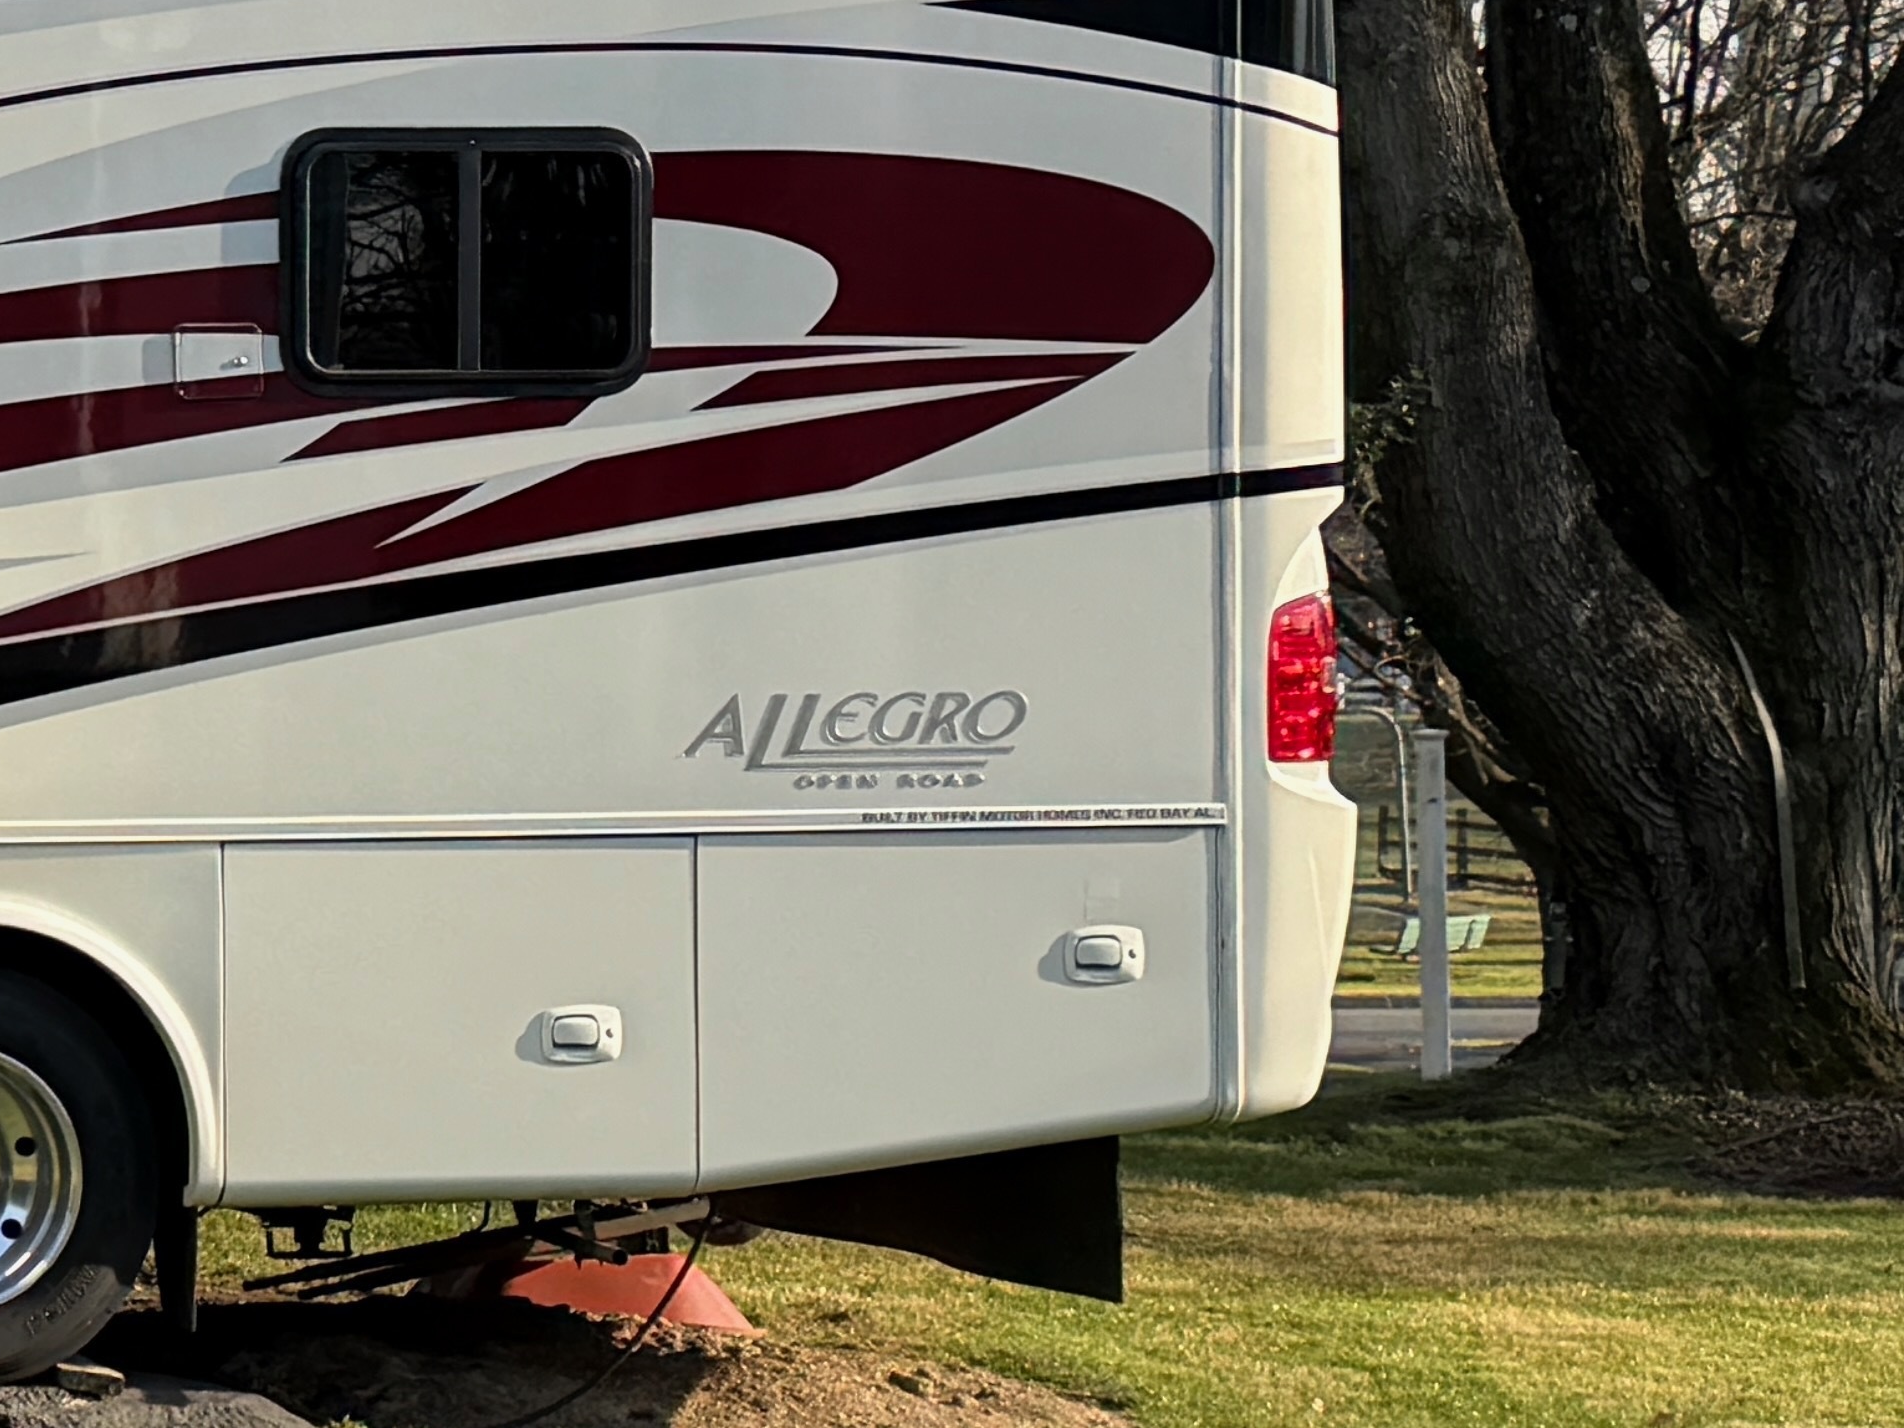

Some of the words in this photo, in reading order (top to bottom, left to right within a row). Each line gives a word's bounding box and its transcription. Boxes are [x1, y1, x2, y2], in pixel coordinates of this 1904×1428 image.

[681, 689, 1028, 771] ALLEGRO
[792, 774, 879, 790] OPEN
[896, 773, 986, 789] ROAD
